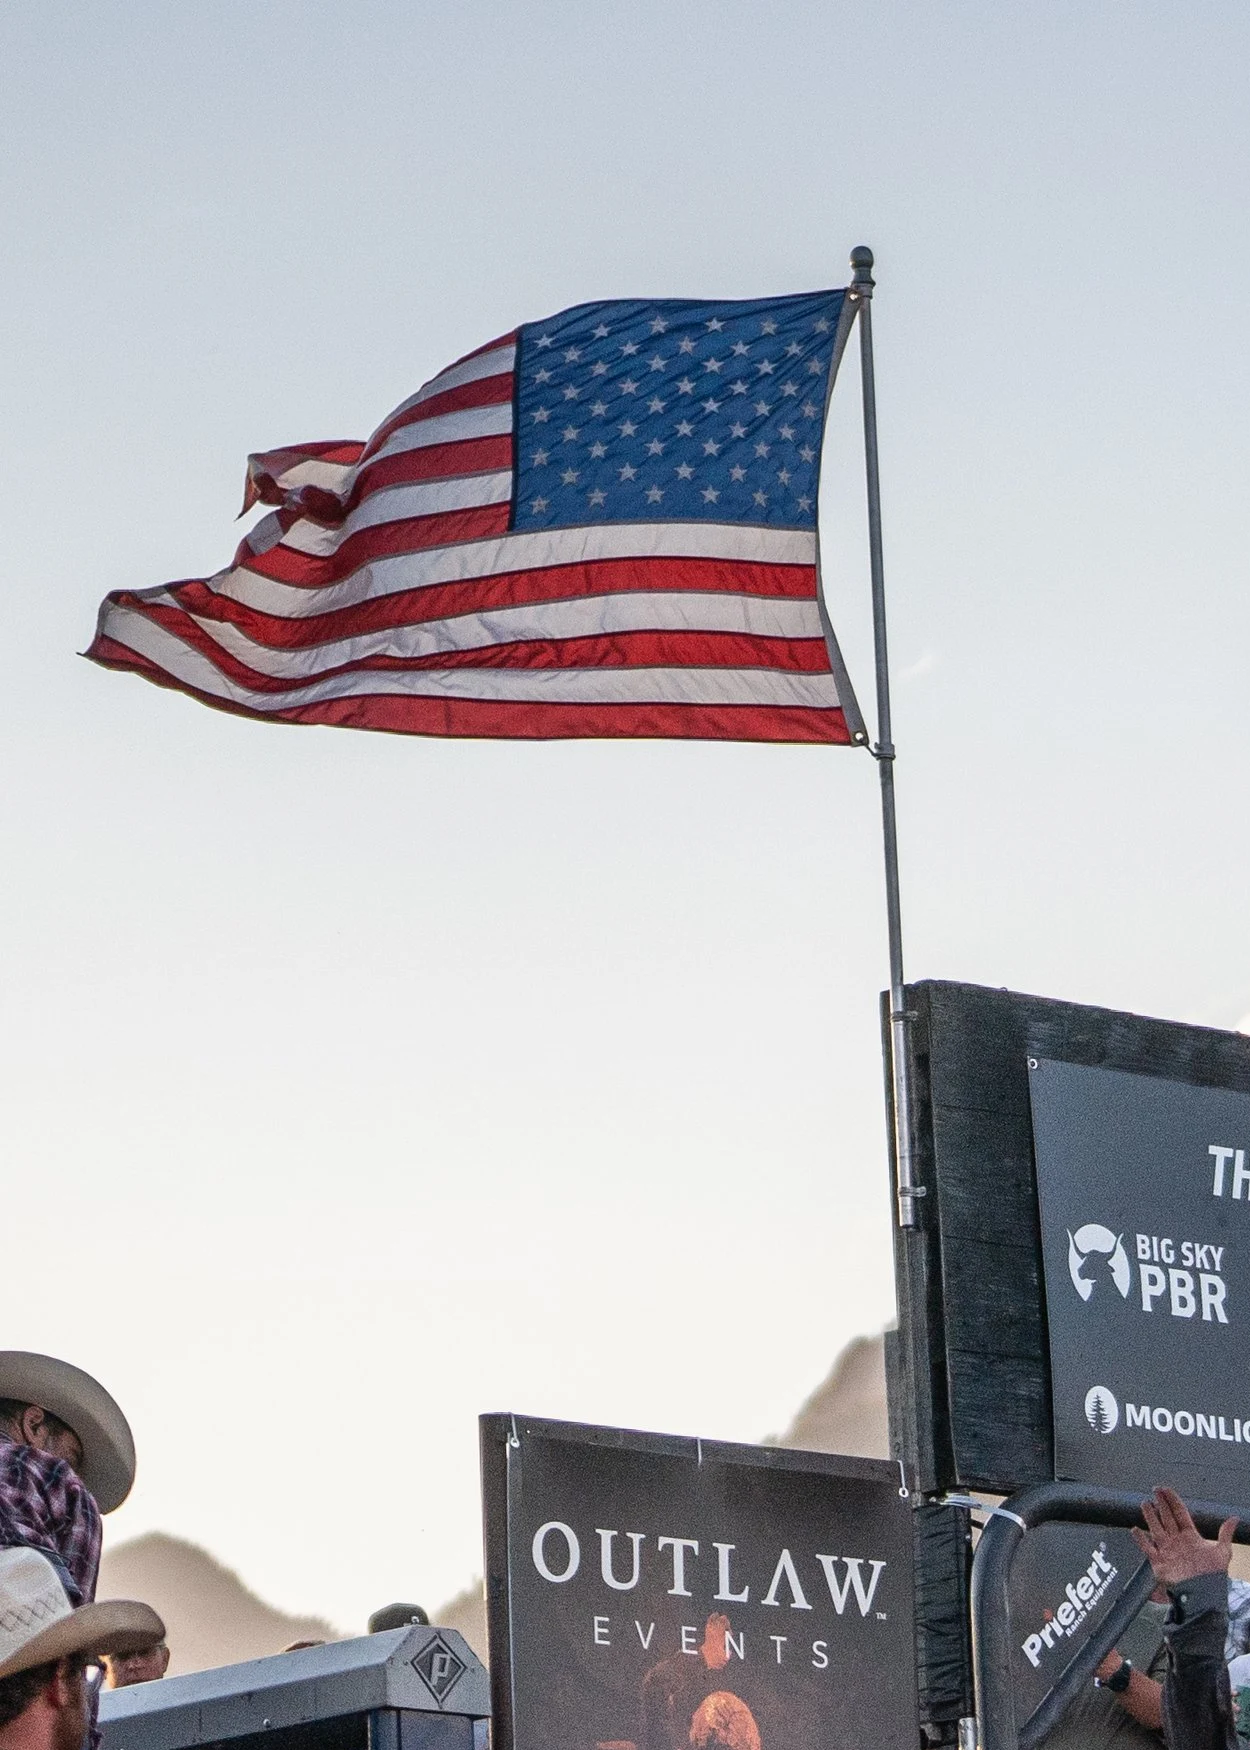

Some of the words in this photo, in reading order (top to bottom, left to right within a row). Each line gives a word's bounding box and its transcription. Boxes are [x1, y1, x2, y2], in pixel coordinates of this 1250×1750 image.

[1135, 1233, 1175, 1264] BIG
[1181, 1241, 1225, 1272] SKY
[1138, 1263, 1229, 1324] PBR
[531, 1520, 888, 1618] OUTLAW
[1064, 1609, 1088, 1637] Ranch
[1084, 1566, 1119, 1611] Equipment
[1021, 1548, 1113, 1668] Priefert
[593, 1614, 830, 1669] EVENTS
